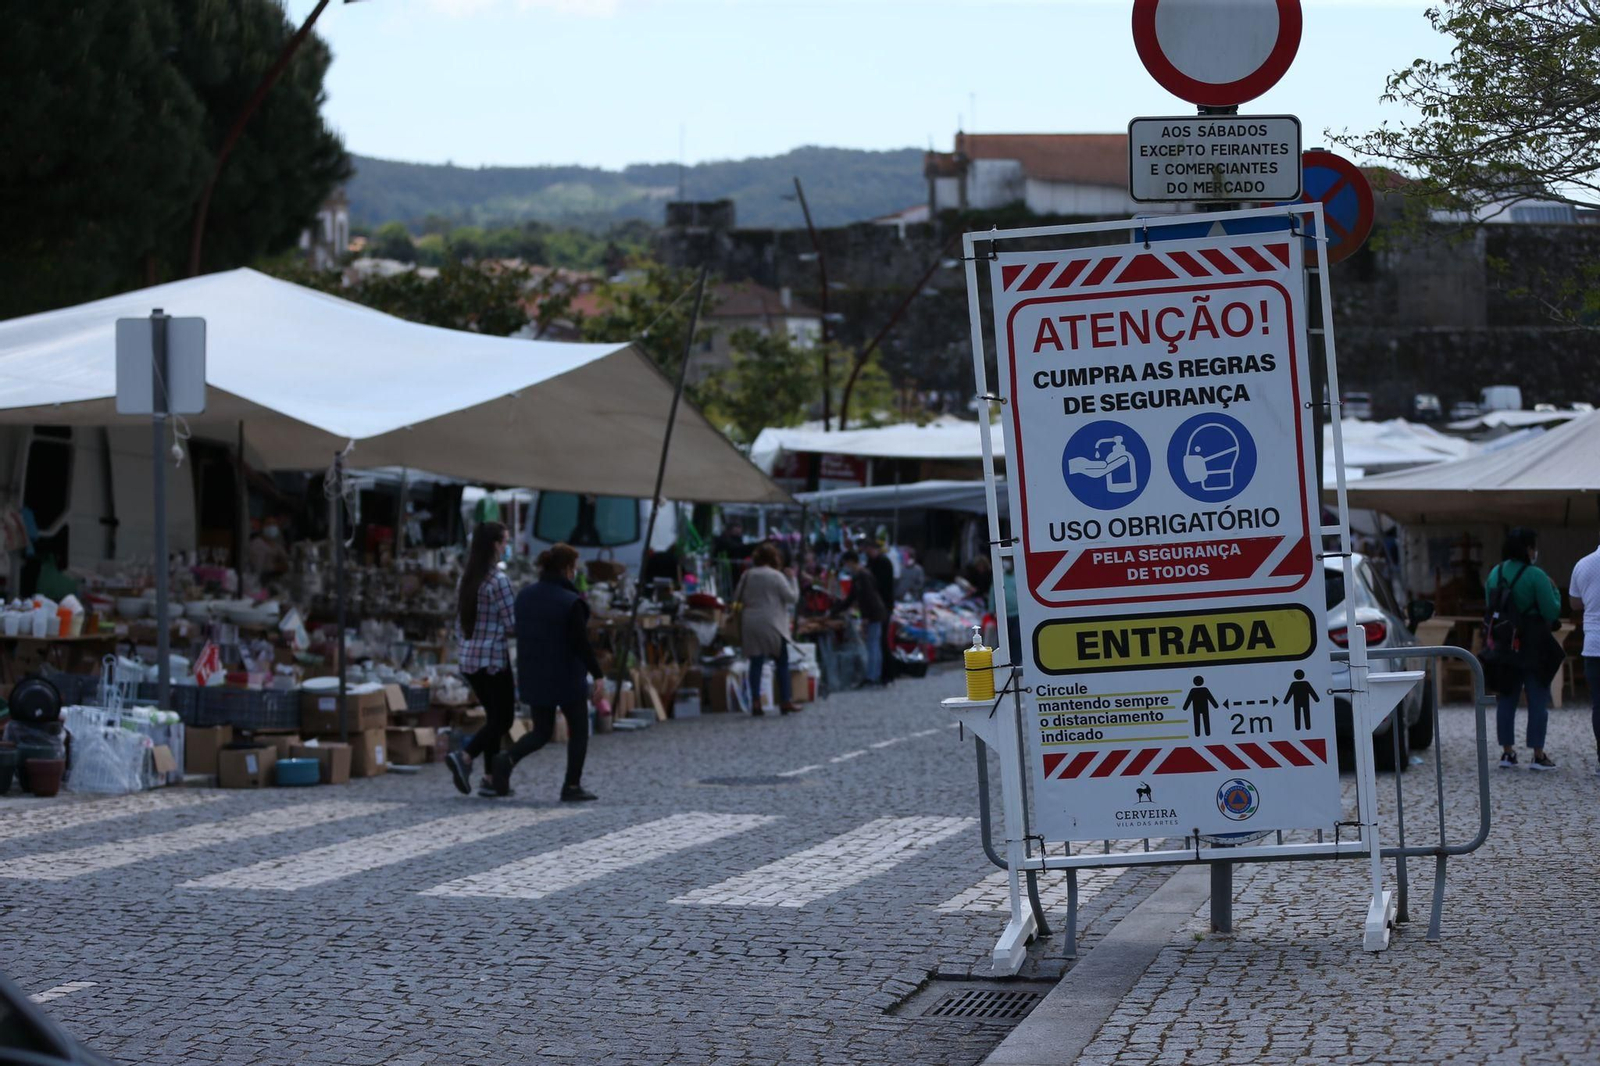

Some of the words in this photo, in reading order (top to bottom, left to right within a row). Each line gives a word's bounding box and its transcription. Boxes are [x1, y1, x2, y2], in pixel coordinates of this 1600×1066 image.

[1161, 126, 1191, 138] AOS
[1198, 123, 1266, 137] SÁBADOS
[1140, 144, 1206, 157] EXCEPTO
[1211, 143, 1289, 156] FEIRANTES
[1151, 164, 1159, 175] E
[1165, 163, 1277, 175] COMERCIANTES
[1167, 182, 1188, 194] DO
[1194, 180, 1265, 193] MERCADO
[1033, 295, 1270, 354] ATENÇÃO!
[1033, 363, 1137, 389] CUMPRA
[1141, 361, 1174, 381] AS
[1179, 353, 1276, 378] REGRAS
[1064, 395, 1096, 415] DE
[1100, 384, 1250, 411] SEGURANÇA
[1049, 519, 1102, 542] USO
[1108, 505, 1281, 537] OBRIGATÓRIO
[1093, 549, 1136, 565] PELA
[1138, 543, 1242, 562] SEGURANÇA
[1127, 566, 1149, 581] DE
[1152, 563, 1210, 579] TODOS
[1076, 619, 1276, 661] ENTRADA
[1036, 683, 1088, 697] Circule
[1038, 697, 1111, 712] mantendo
[1115, 696, 1169, 709] sempre
[1040, 718, 1049, 728] o
[1053, 710, 1164, 727] distanciamento
[1041, 728, 1104, 743] indicado
[1115, 808, 1178, 820] CERVEIRA
